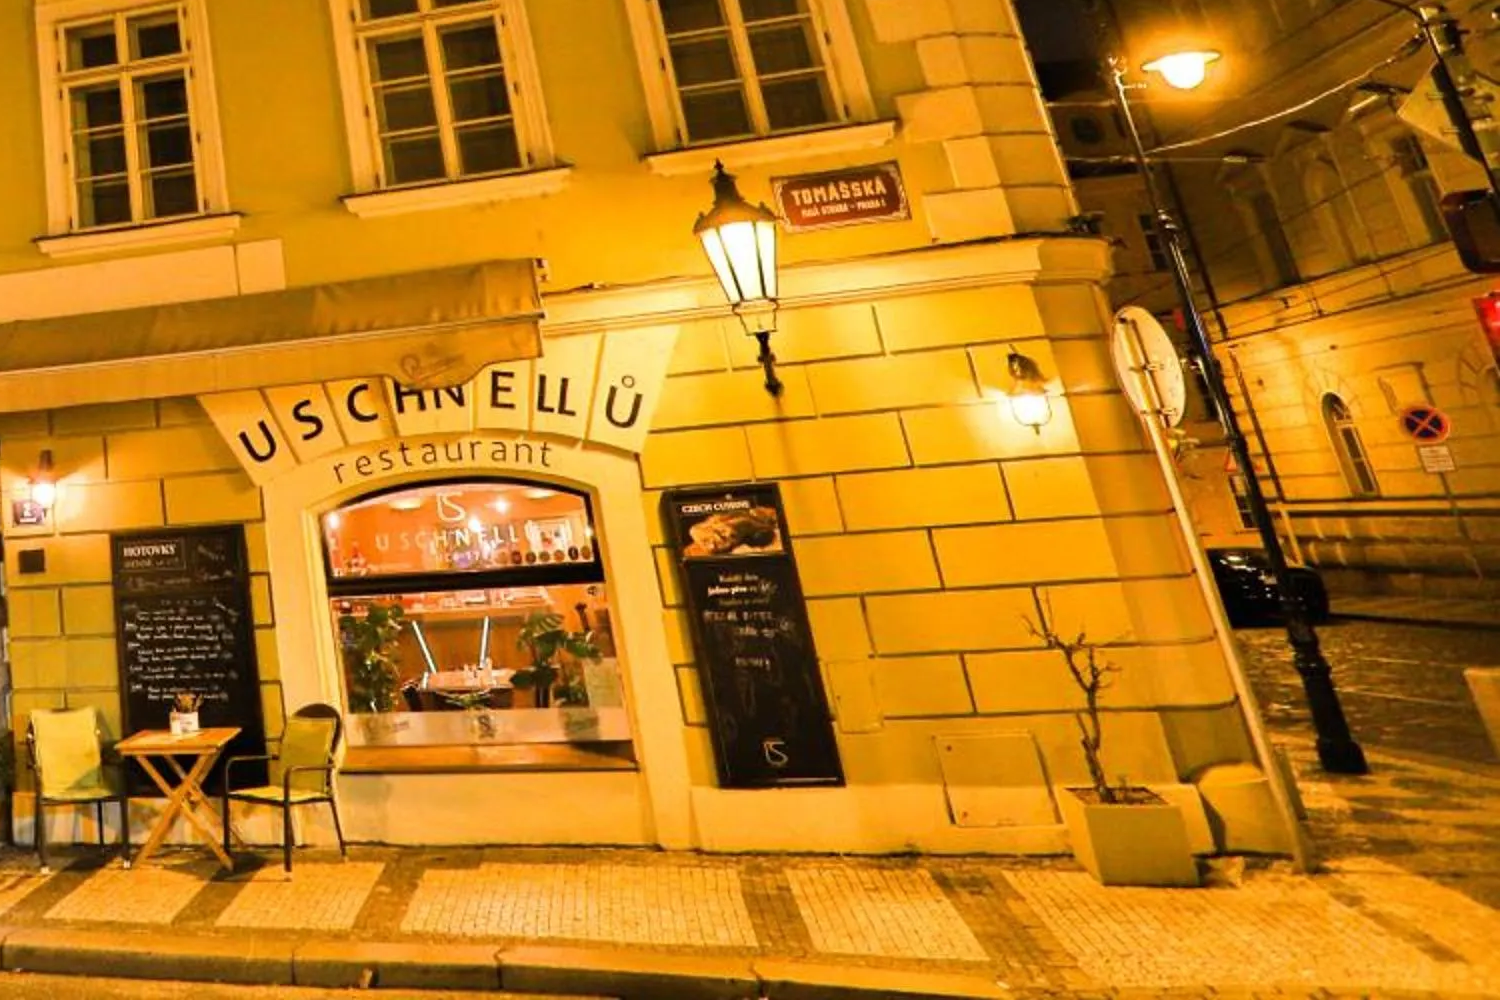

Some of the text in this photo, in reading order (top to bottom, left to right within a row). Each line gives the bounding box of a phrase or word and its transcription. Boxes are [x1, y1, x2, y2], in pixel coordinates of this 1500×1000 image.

[790, 175, 887, 206] TOMÁŠSKÁ
[239, 420, 277, 463] U
[332, 439, 554, 484] restaurant
